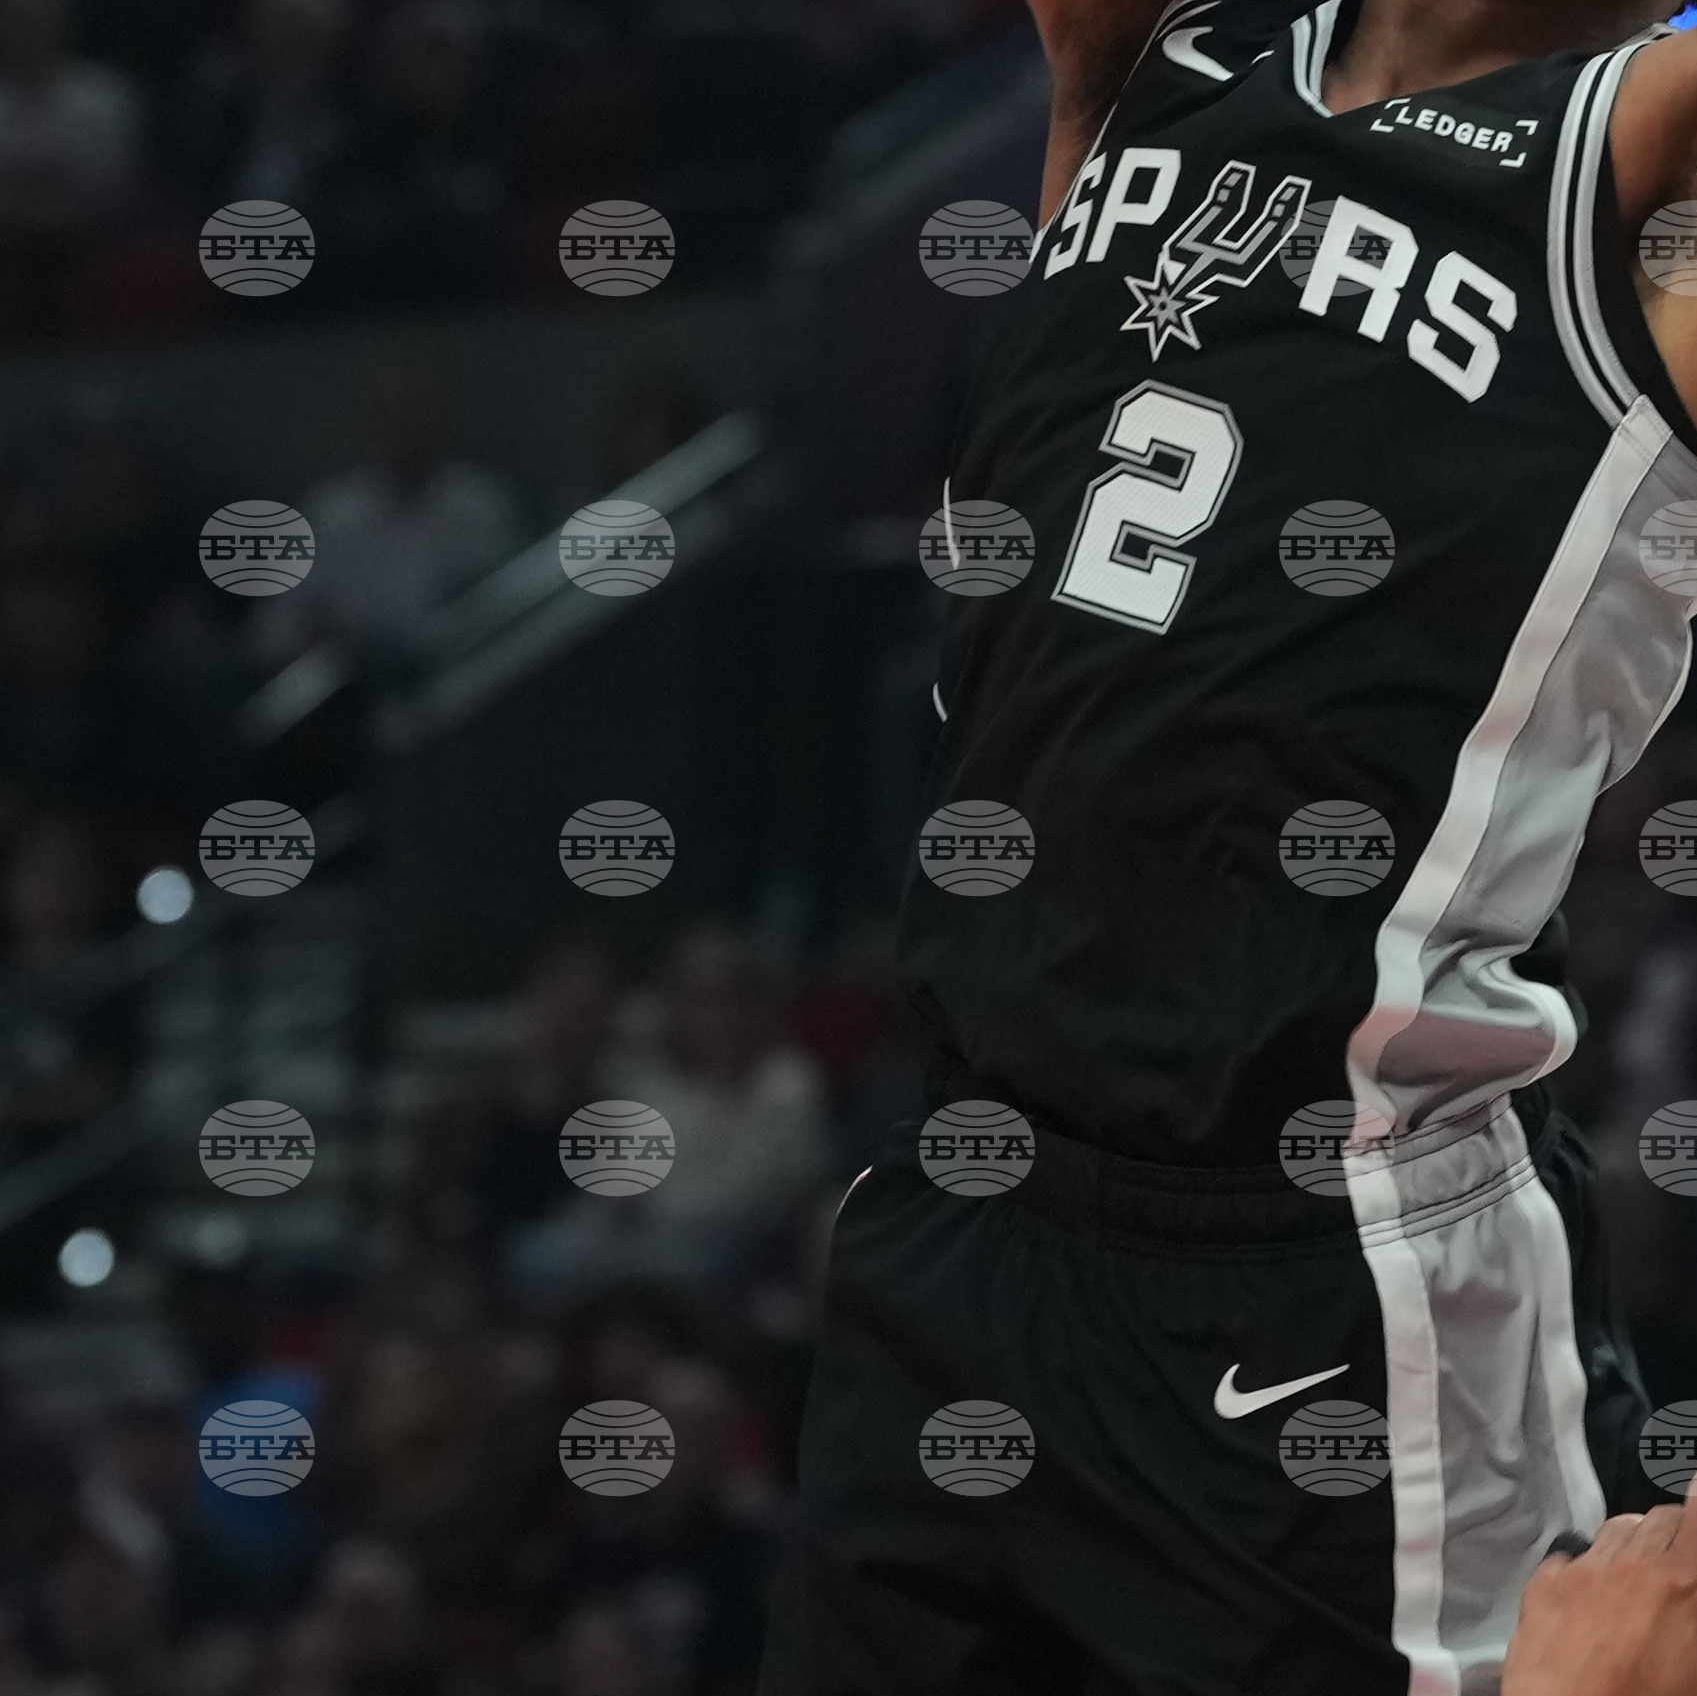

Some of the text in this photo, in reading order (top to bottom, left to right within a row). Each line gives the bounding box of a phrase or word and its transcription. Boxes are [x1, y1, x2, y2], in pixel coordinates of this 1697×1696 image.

[1395, 104, 1514, 155] LEDGER
[1042, 147, 1519, 403] SPURS
[1050, 378, 1246, 636] 2
